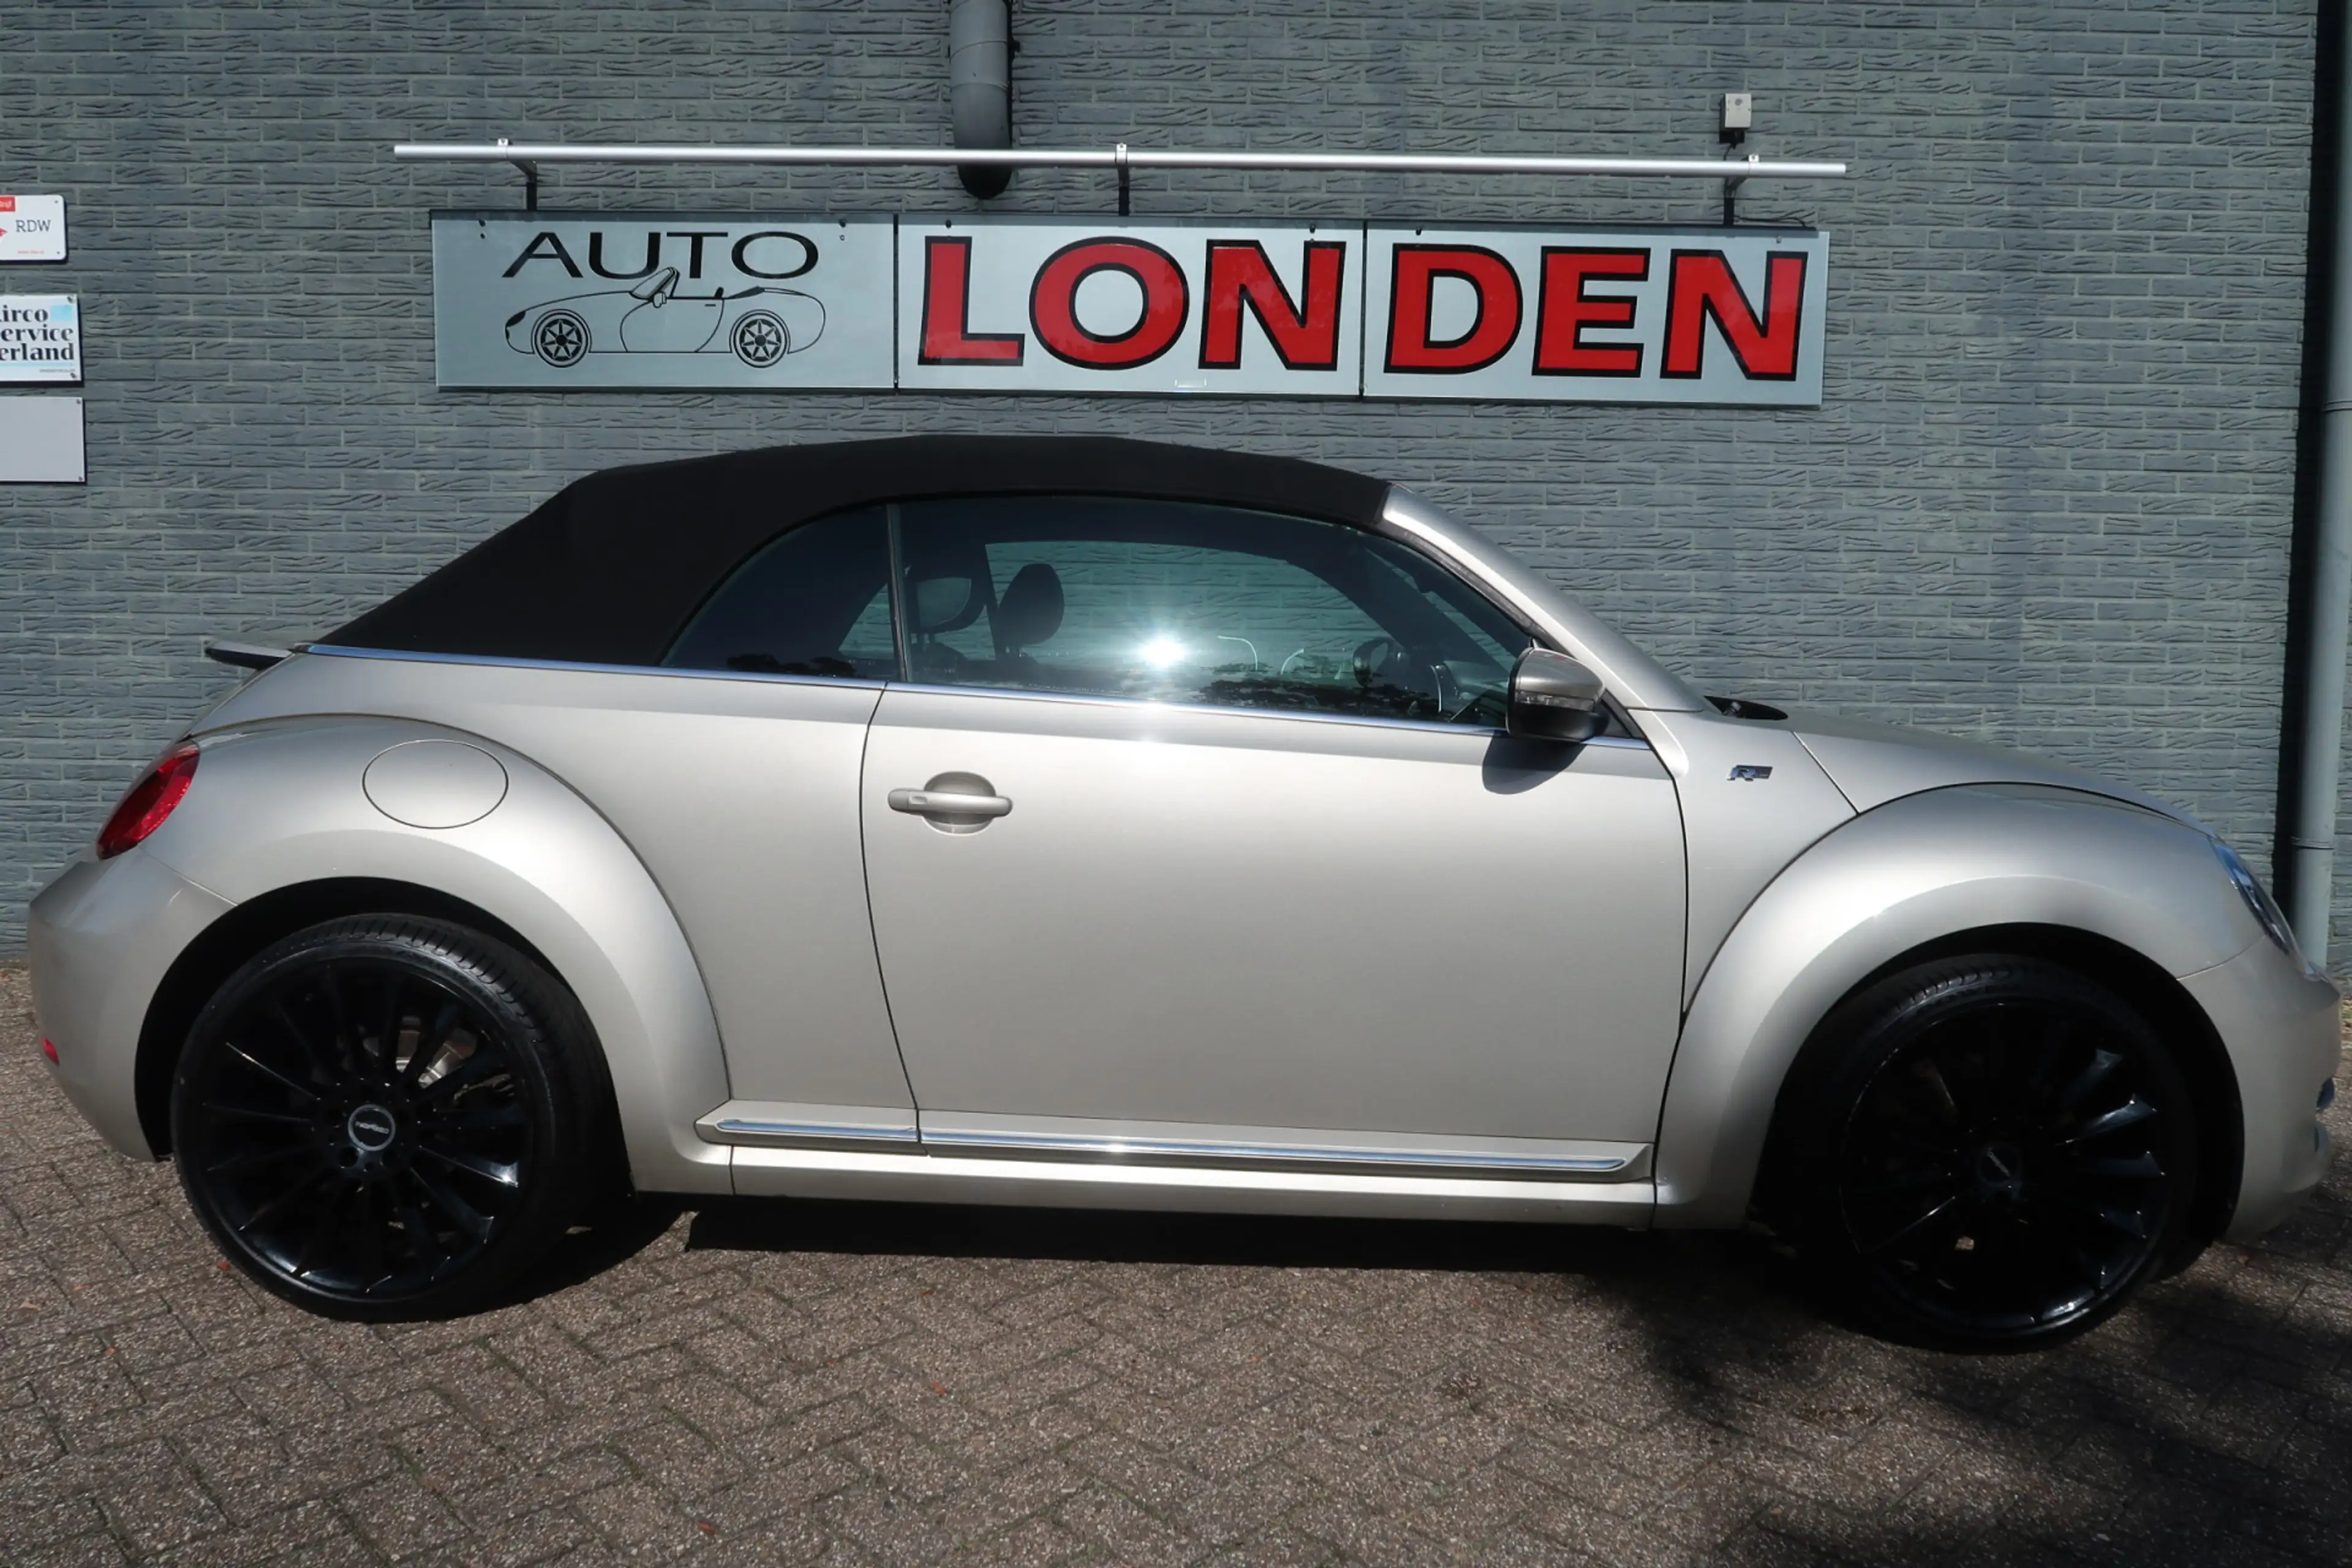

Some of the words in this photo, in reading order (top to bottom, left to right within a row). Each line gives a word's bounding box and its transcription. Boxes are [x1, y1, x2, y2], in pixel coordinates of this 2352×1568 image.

[15, 219, 51, 232] RDW
[0, 304, 48, 322] irco
[502, 231, 819, 280] AUTO
[918, 236, 1808, 382] LONDEN
[1, 323, 74, 341] ervice
